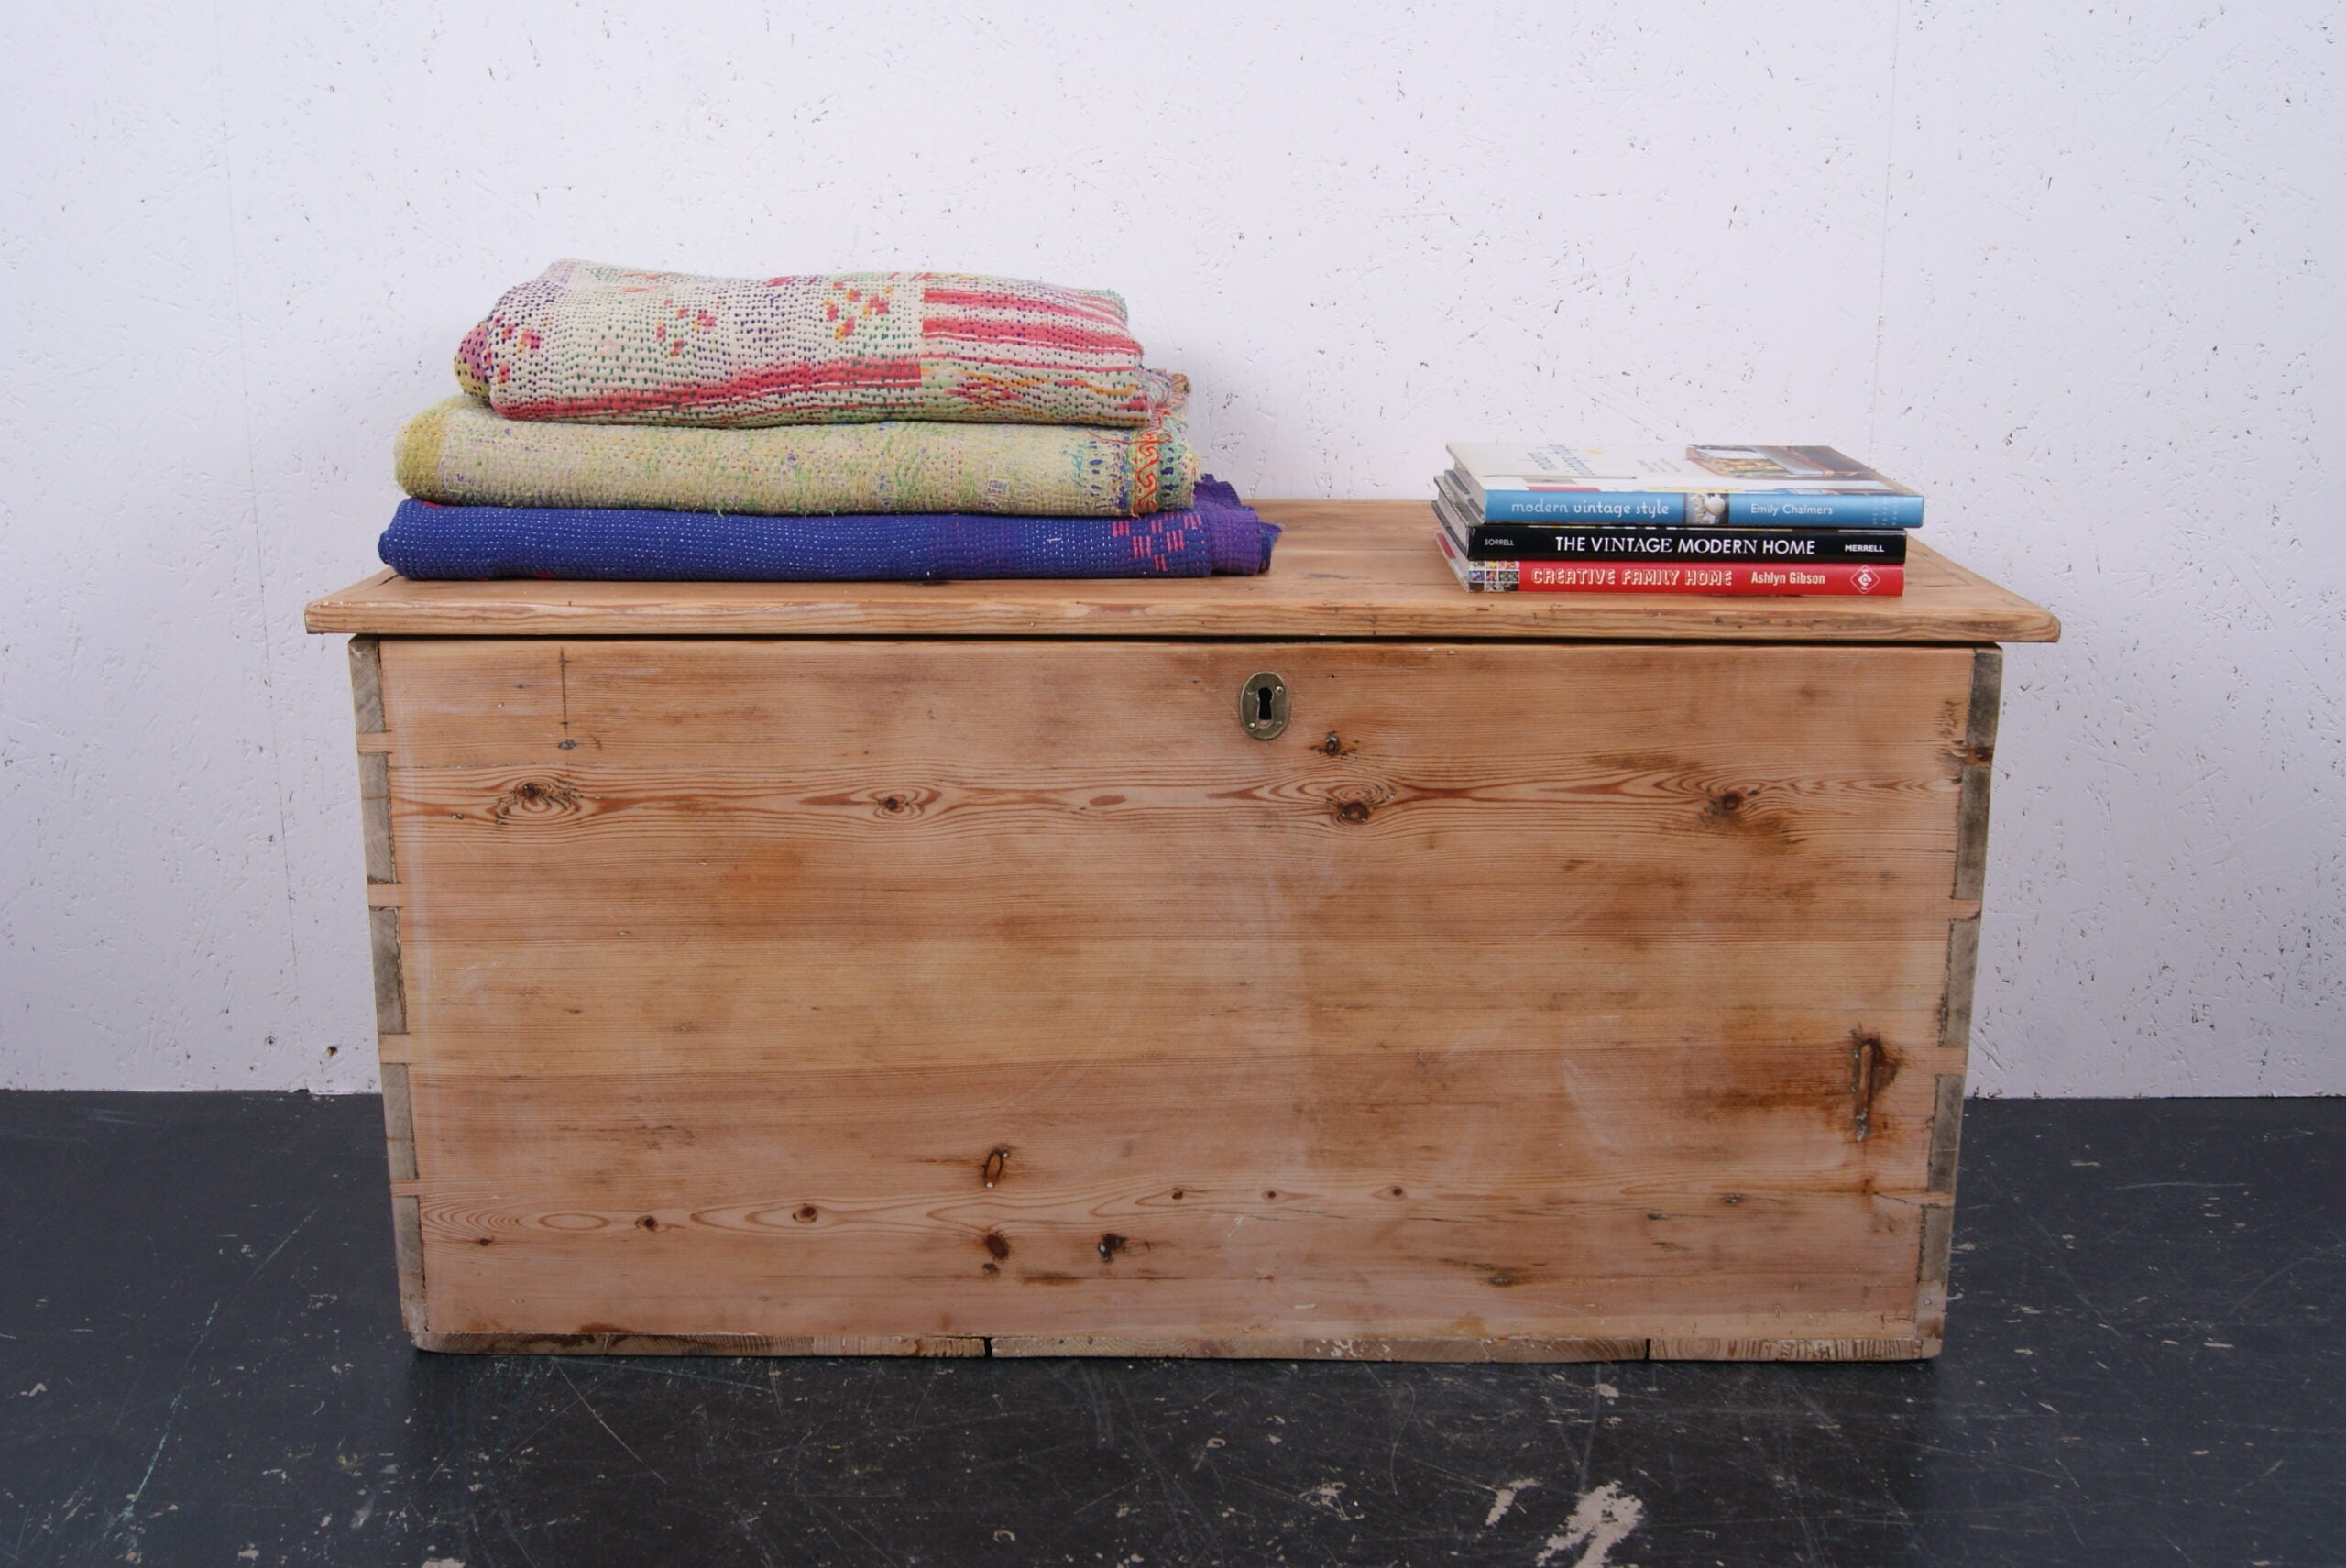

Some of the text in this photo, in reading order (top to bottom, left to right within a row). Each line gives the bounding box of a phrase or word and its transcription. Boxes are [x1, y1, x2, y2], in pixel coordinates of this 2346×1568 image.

[1512, 499, 1669, 519] modern vintage style
[1750, 503, 1834, 517] Emily Chalmers
[1485, 538, 1515, 546] SORRELL
[1556, 536, 1816, 554] THE VINTAGE MODERN HOME
[1845, 543, 1885, 553] MERRELL
[1531, 568, 1732, 586] CREATIVE FAMILY HOME
[1751, 571, 1825, 587] Ashlyn Gibson
